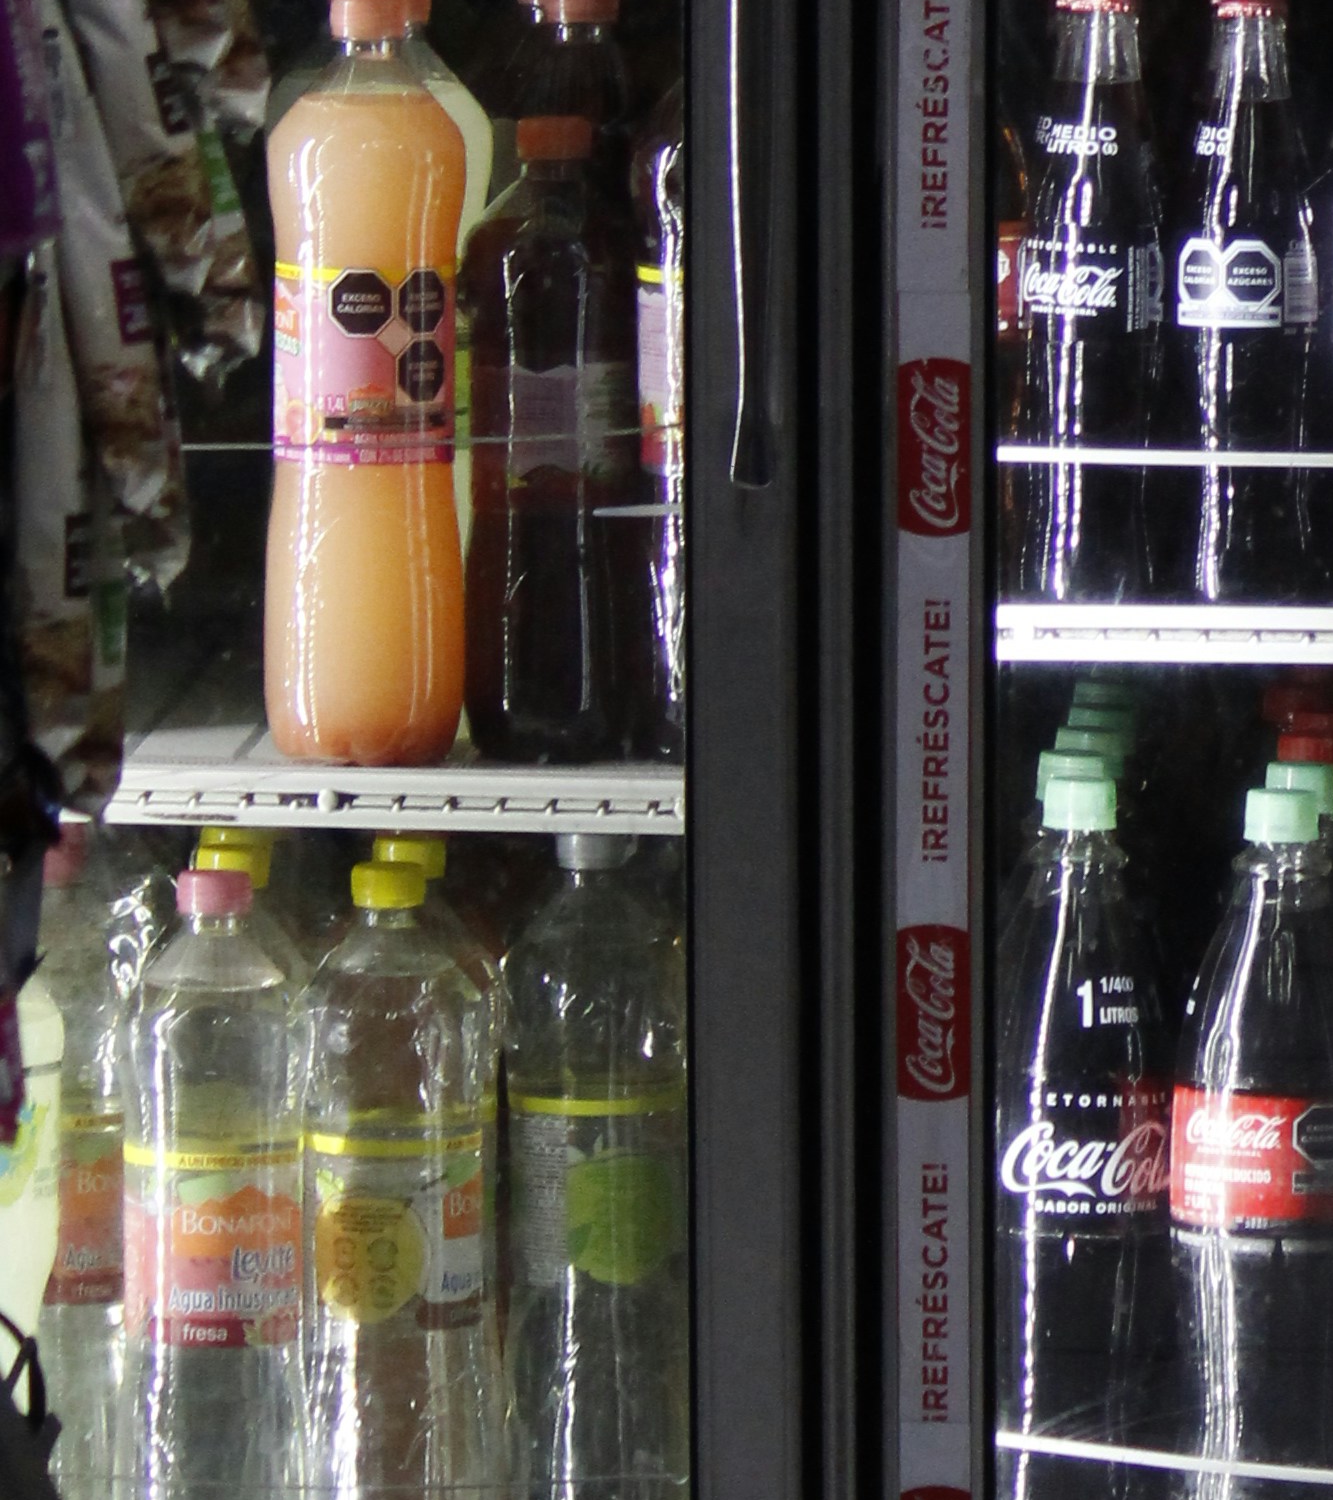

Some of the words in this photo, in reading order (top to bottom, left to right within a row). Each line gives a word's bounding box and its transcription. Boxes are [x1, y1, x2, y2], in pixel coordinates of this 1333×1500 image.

[1024, 263, 1122, 308] Coca-Cola
[909, 369, 961, 528] Coca-Cola
[182, 1209, 293, 1234] BONAFONT
[181, 1324, 227, 1342] fresa
